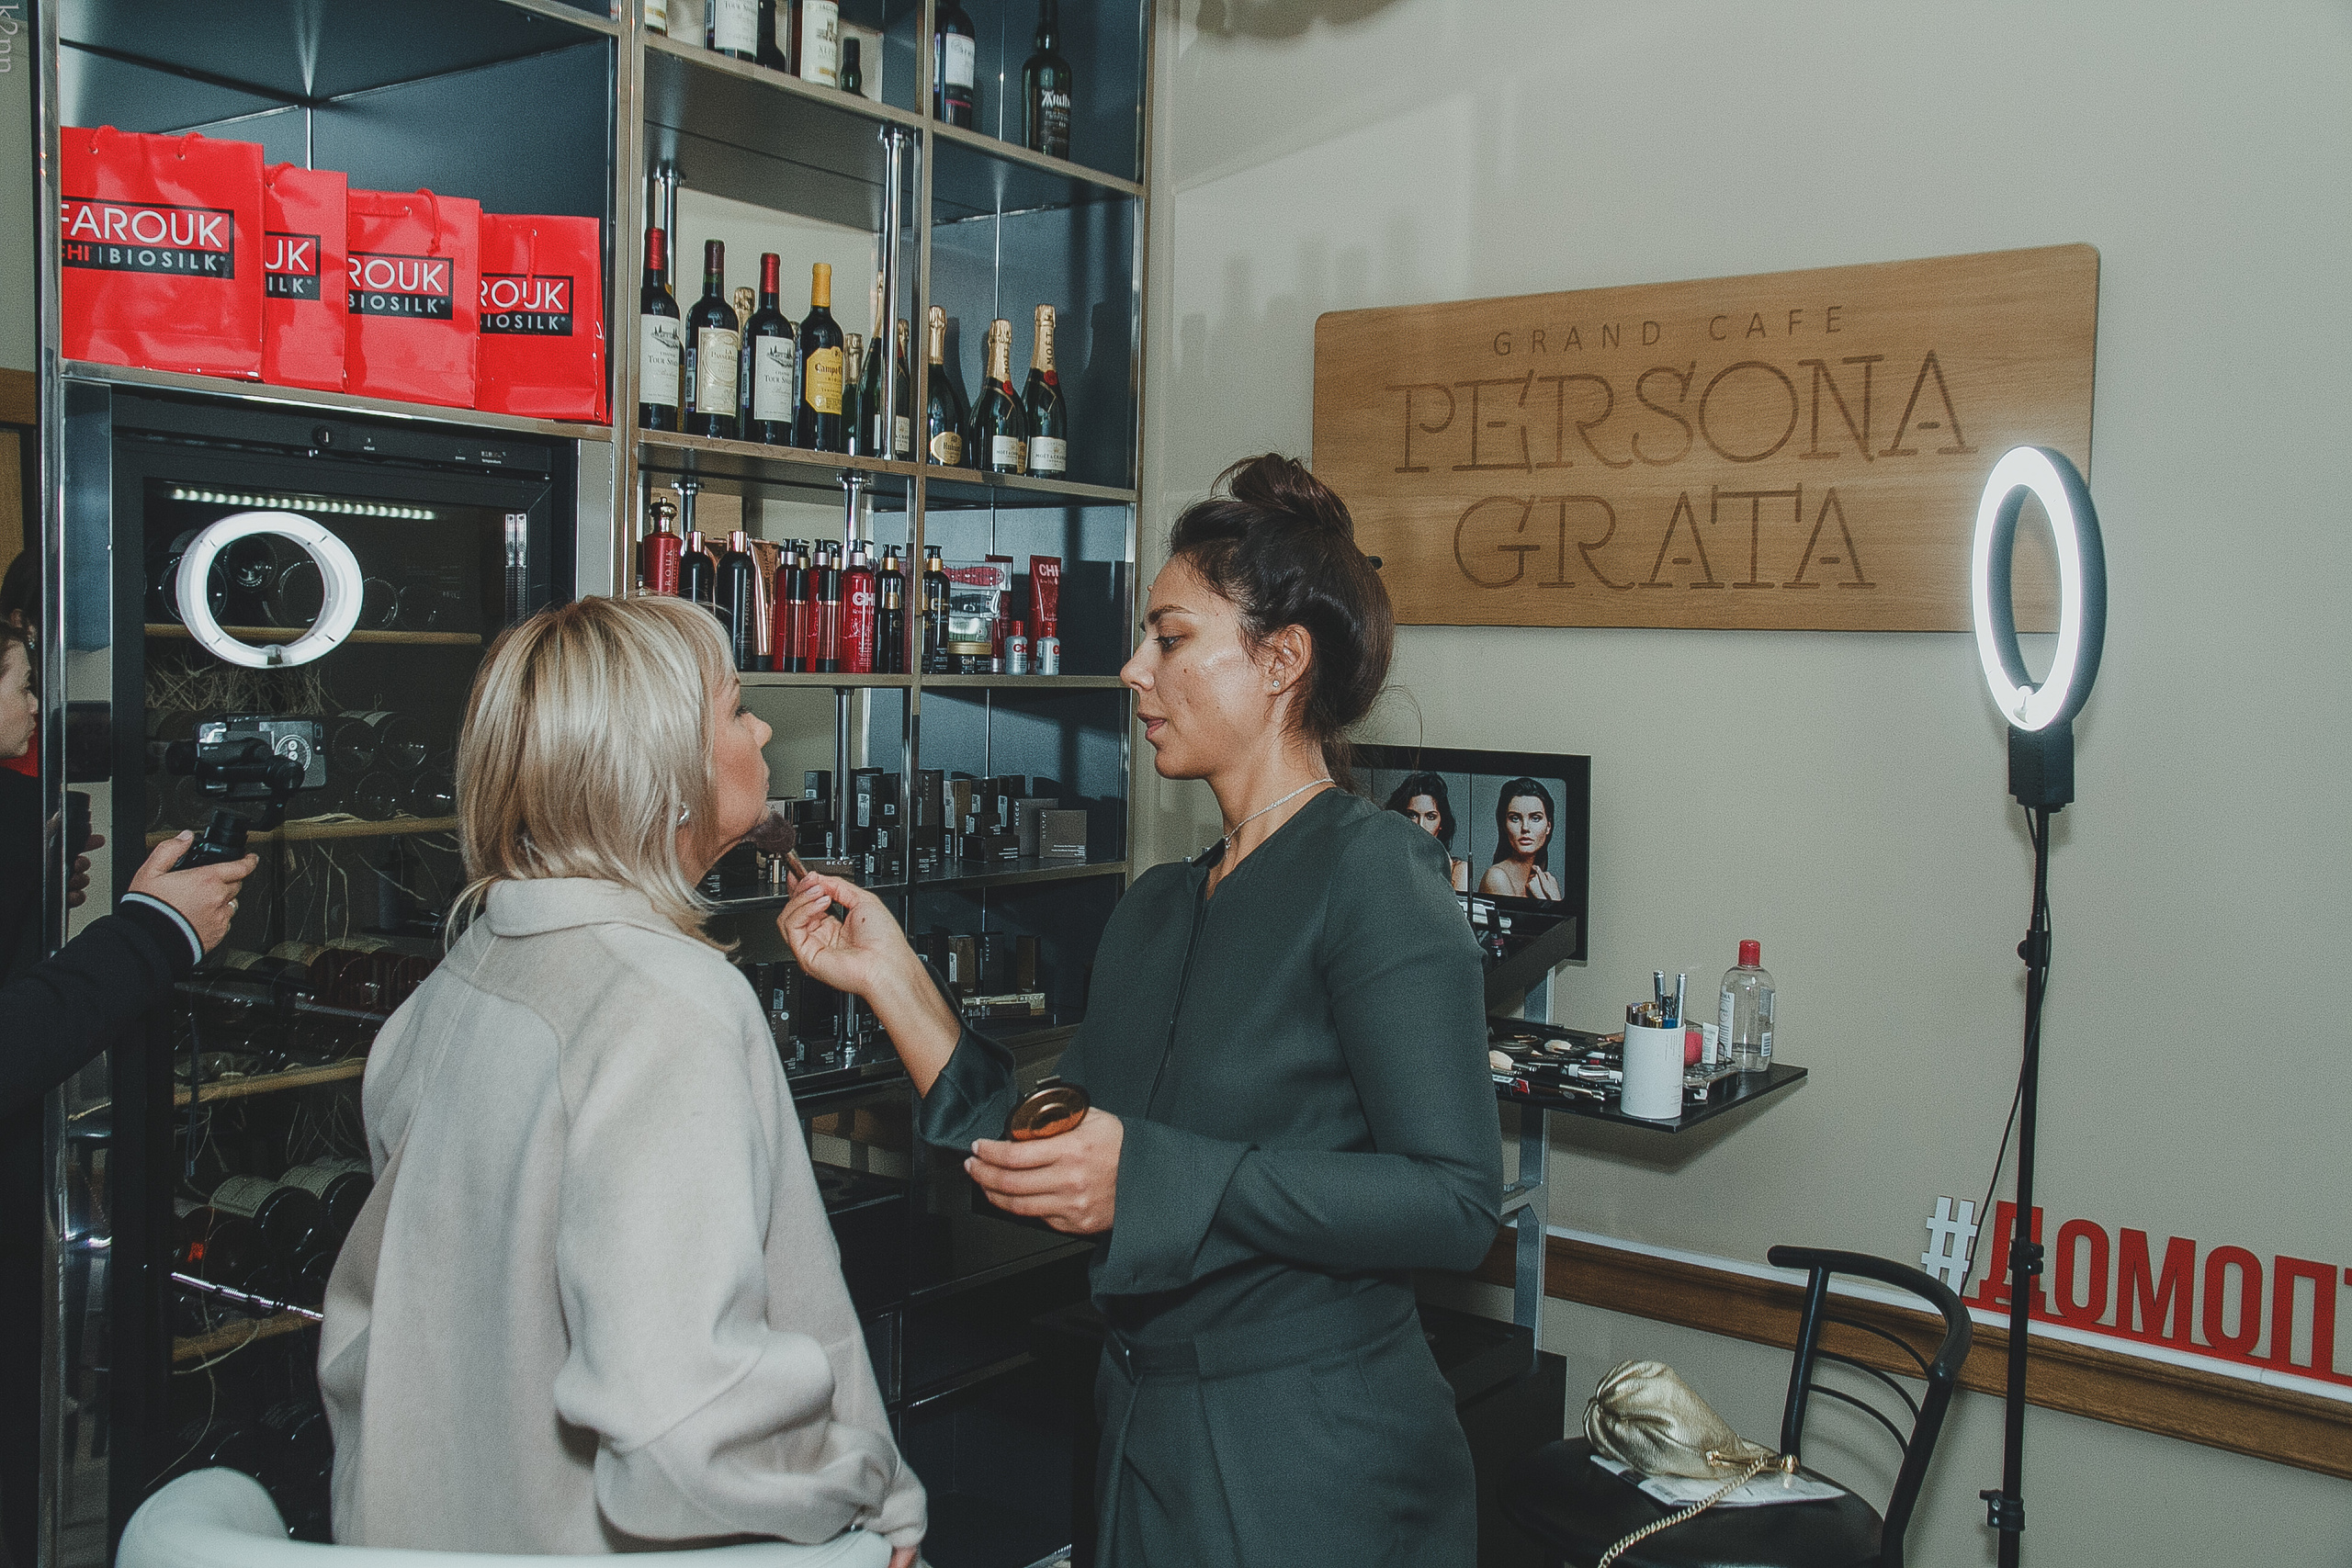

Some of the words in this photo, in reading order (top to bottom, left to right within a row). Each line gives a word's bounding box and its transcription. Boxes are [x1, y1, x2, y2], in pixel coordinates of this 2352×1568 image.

[1493, 321, 1661, 356] GRAND
[1708, 305, 1843, 341] CAFE
[1385, 349, 1979, 473] PERSONA
[1038, 563, 1059, 578] CHI
[1453, 481, 1876, 591] GRATA
[1920, 1195, 2352, 1387] #ДОМОП
